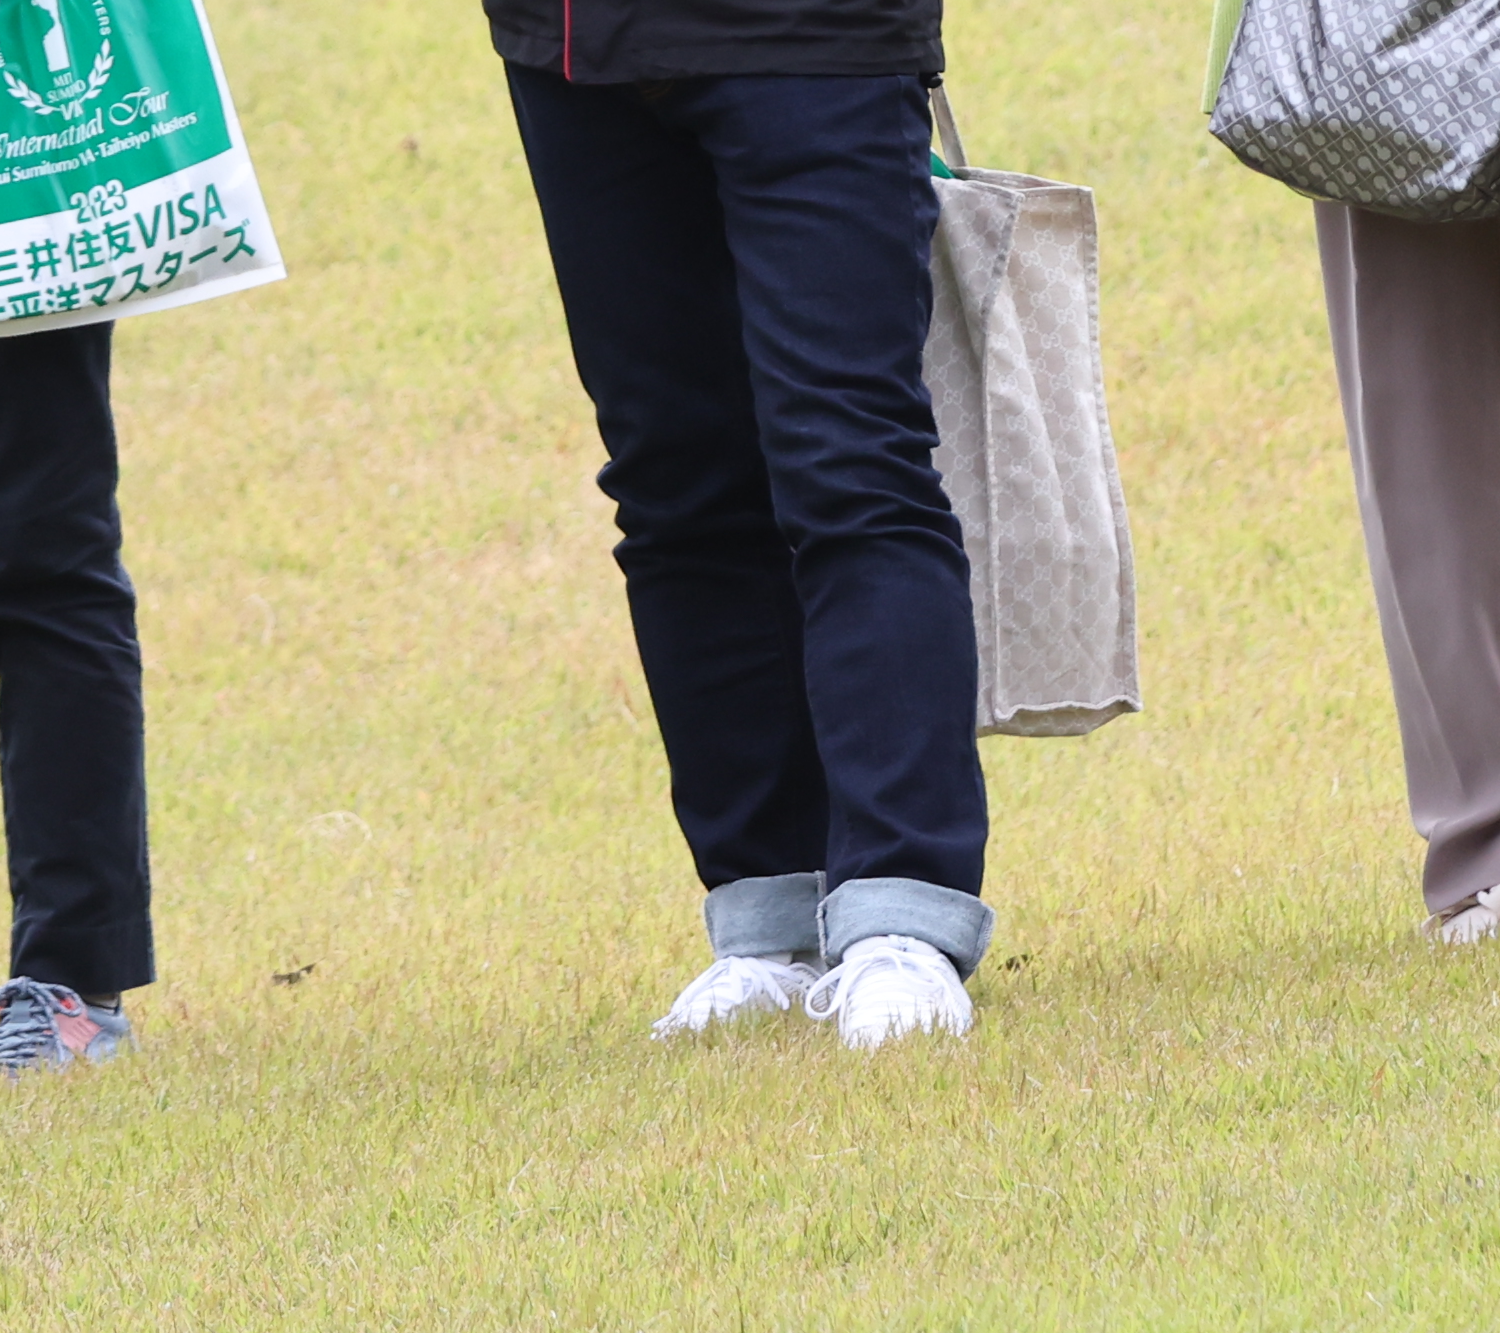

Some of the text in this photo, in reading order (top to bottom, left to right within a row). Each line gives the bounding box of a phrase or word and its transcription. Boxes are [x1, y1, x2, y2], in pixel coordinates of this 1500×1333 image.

[108, 86, 169, 126] Tour
[12, 157, 80, 183] Sumitomo
[151, 112, 197, 140] Masters
